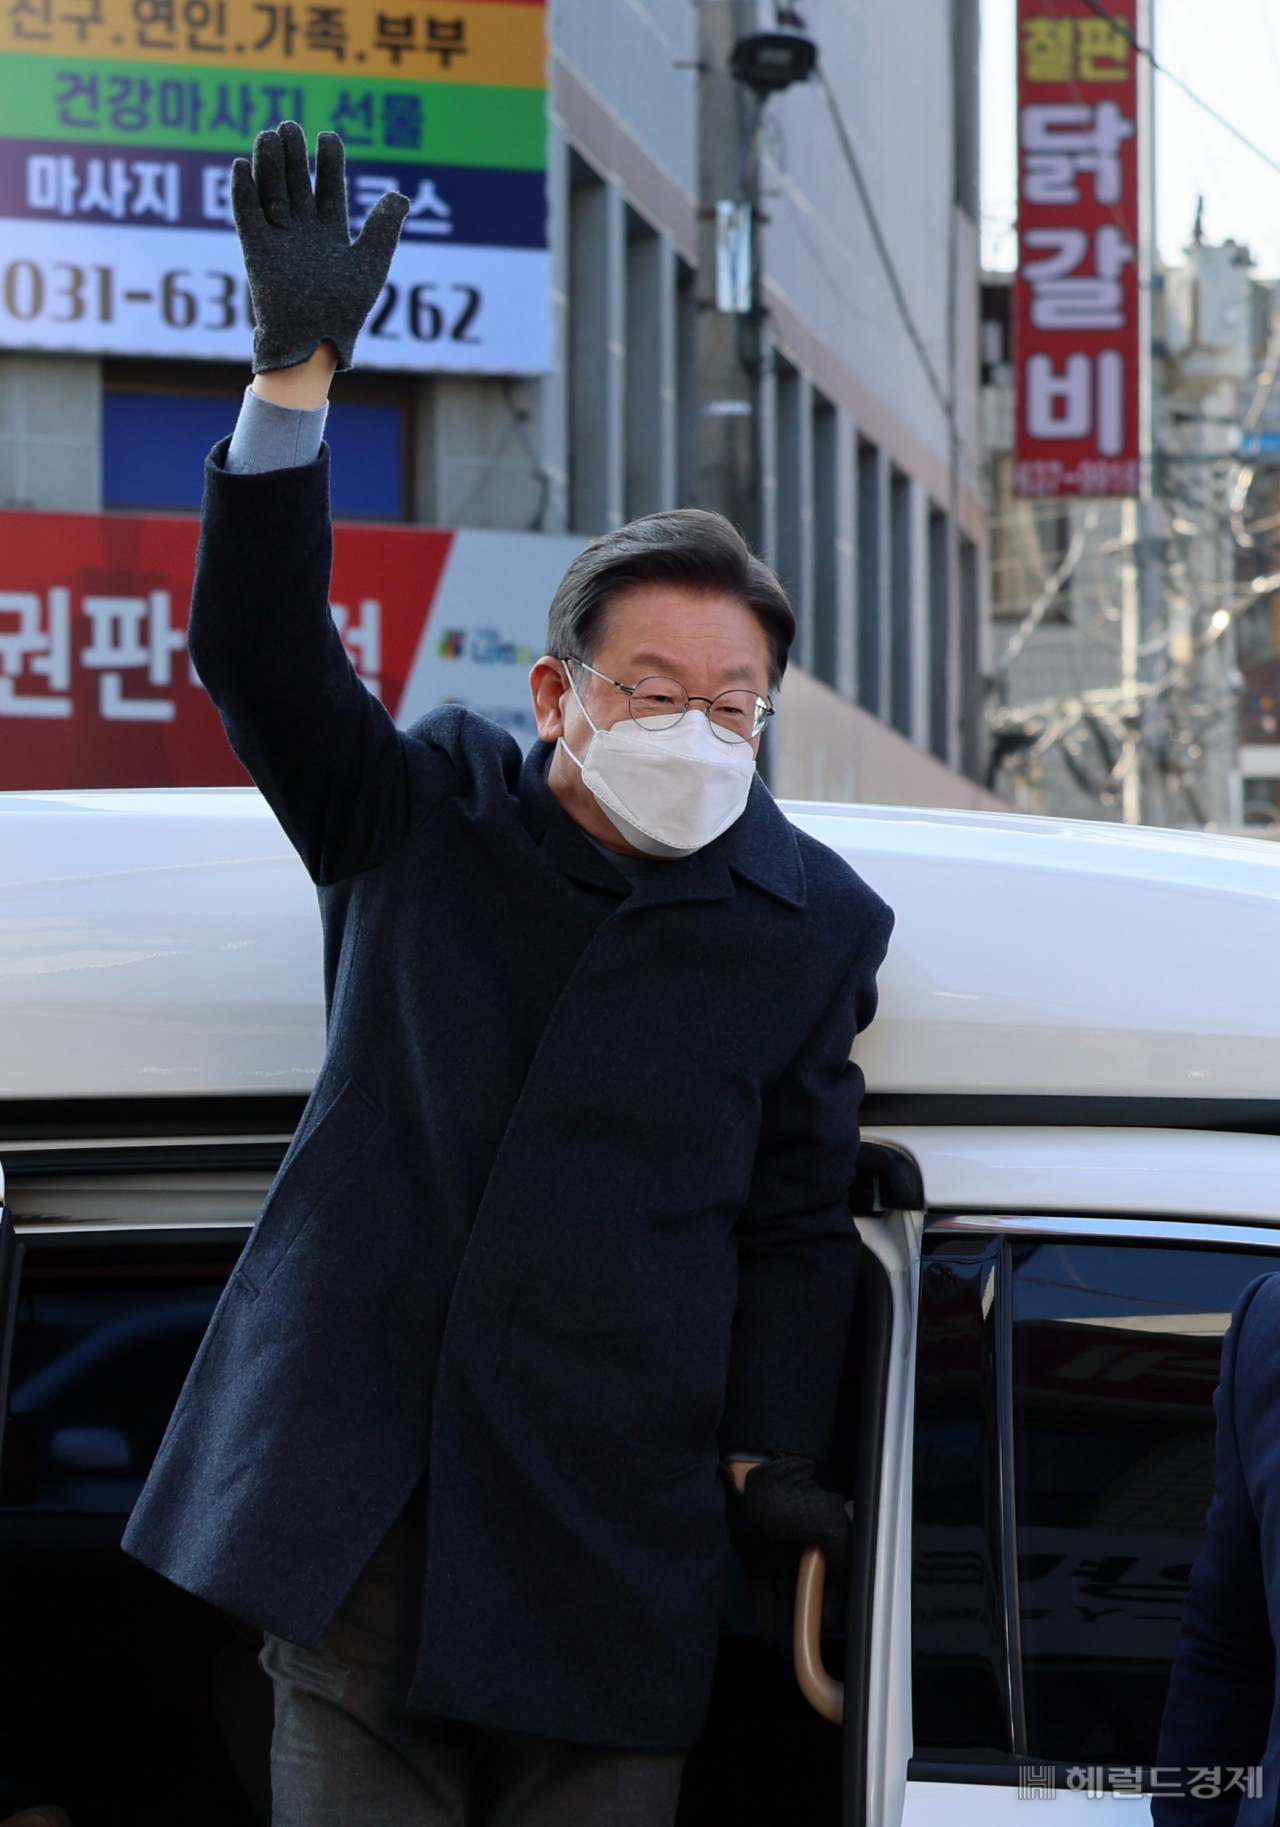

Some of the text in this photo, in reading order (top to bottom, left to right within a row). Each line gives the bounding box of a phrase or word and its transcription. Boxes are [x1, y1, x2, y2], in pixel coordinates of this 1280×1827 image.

[1023, 15, 1130, 82] 철판
[55, 70, 424, 148] 건강마사지 선물
[26, 154, 181, 223] 마사지
[4, 260, 483, 345] 031-63262
[1021, 100, 1135, 457] 닭갈비
